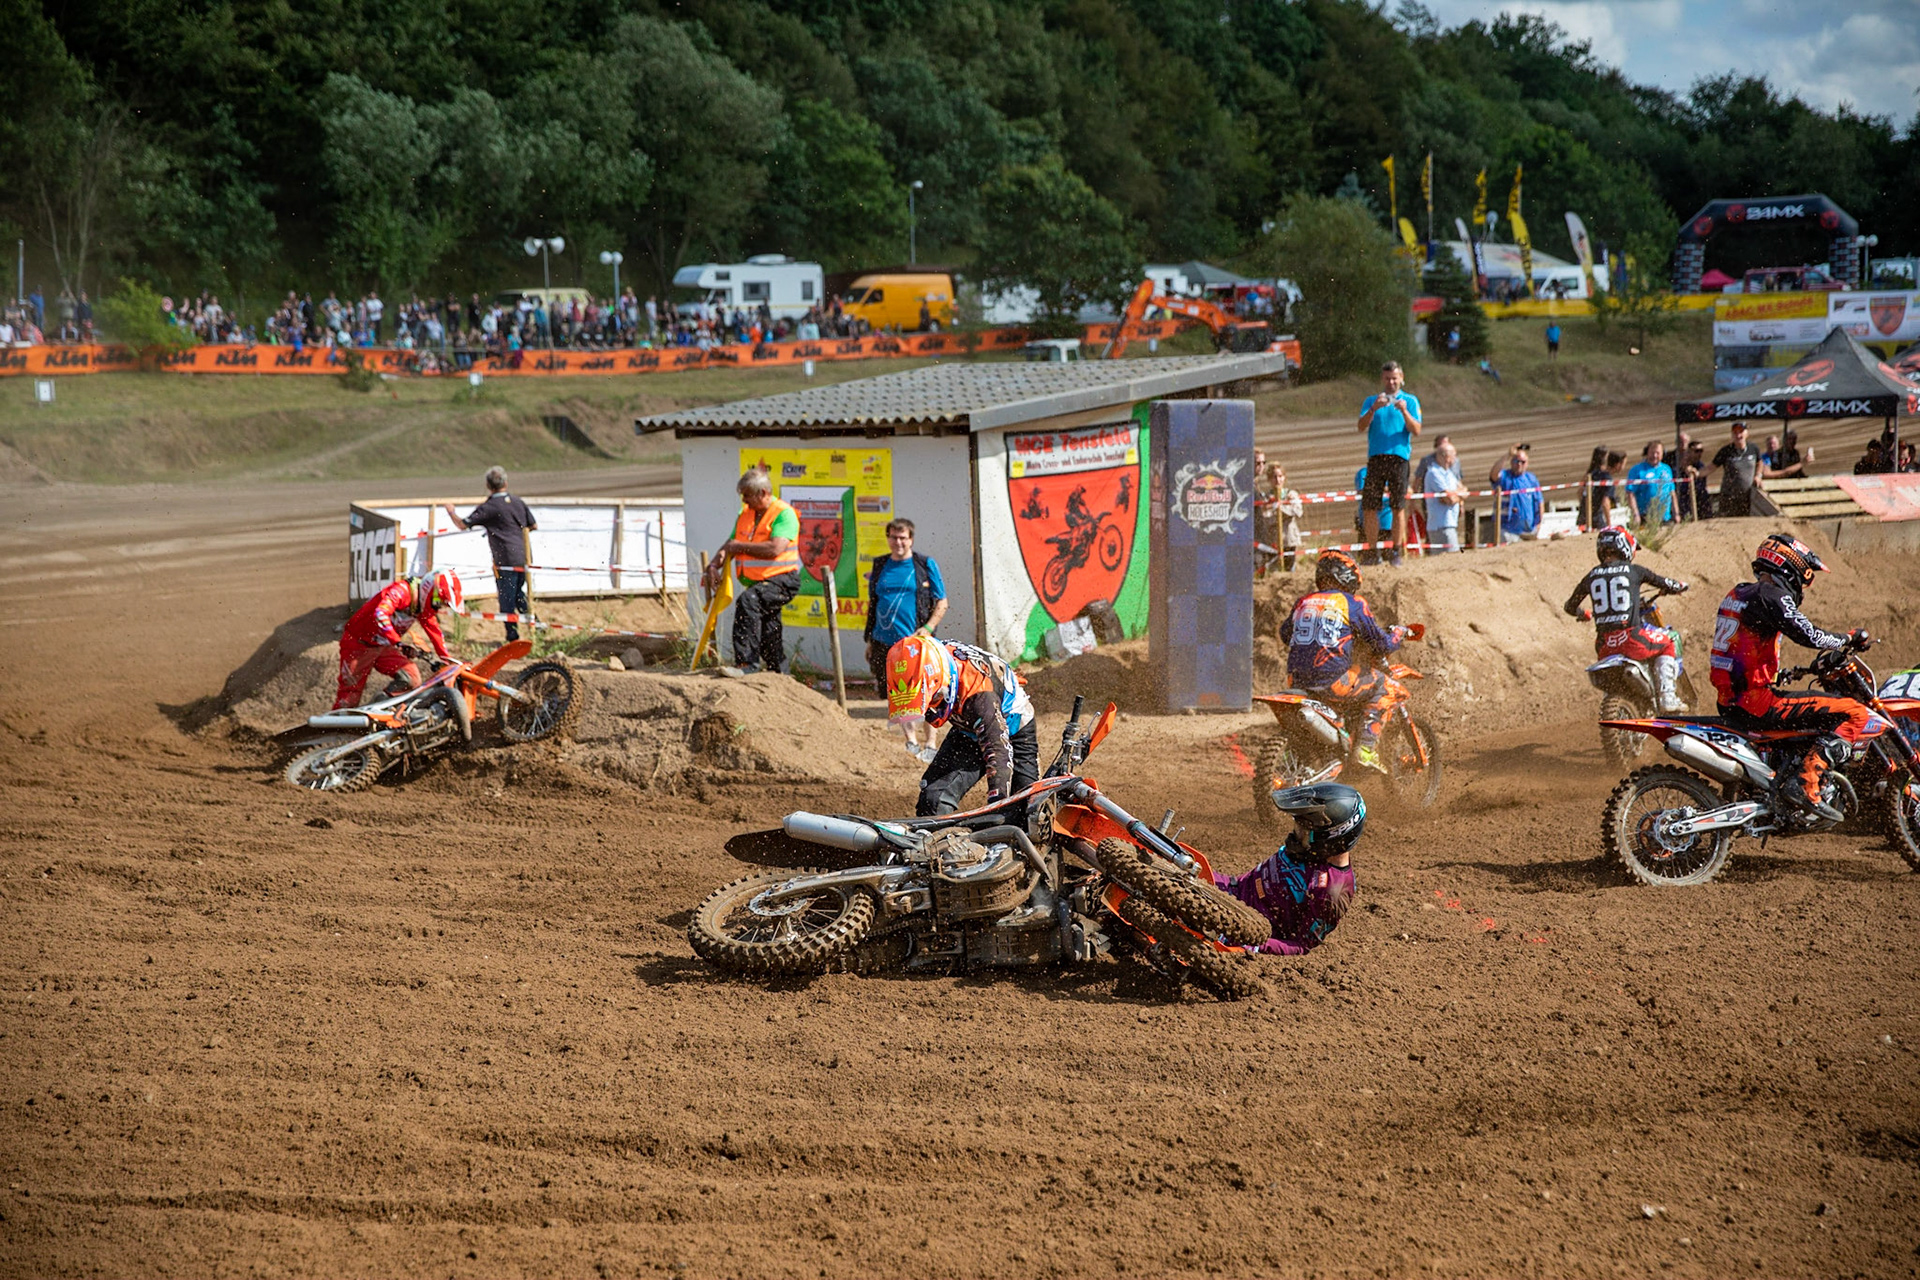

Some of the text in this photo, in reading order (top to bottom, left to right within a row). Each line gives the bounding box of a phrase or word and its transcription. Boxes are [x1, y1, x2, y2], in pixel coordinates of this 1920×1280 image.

[45, 350, 88, 367] KTM
[216, 349, 257, 366] KTM
[1715, 401, 1778, 418] 24MX
[1808, 399, 1873, 415] 24MX
[1014, 424, 1132, 456] MCE Tensfeld
[1186, 489, 1209, 503] Red
[1188, 504, 1229, 519] HOLESHOT
[1591, 575, 1631, 614] 96
[889, 706, 922, 721] adidas
